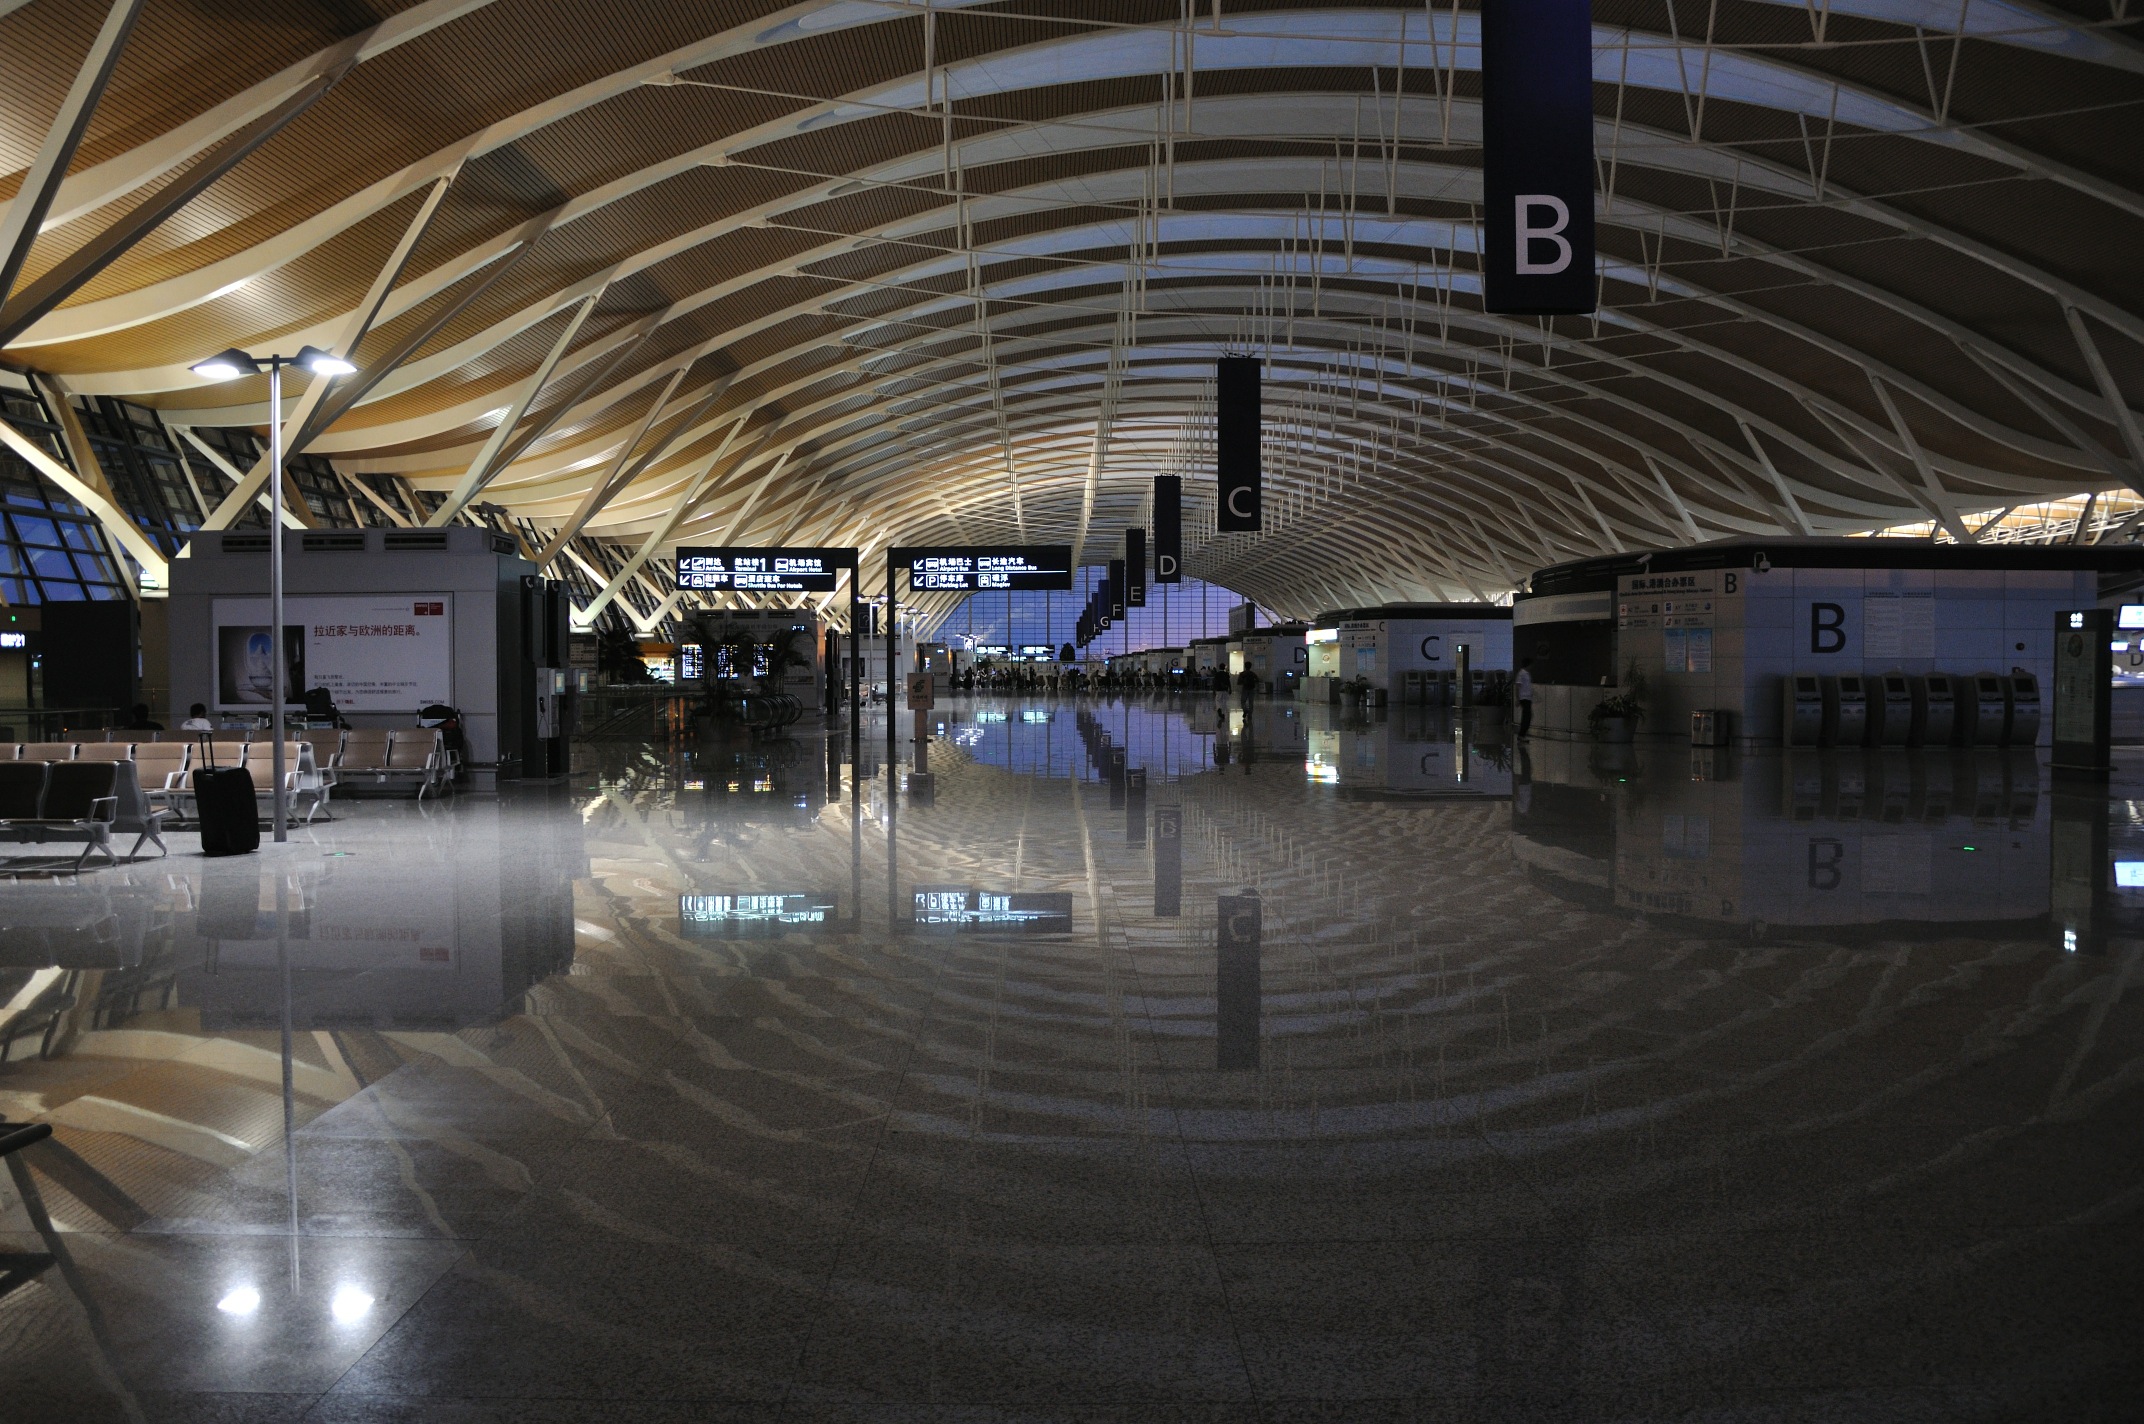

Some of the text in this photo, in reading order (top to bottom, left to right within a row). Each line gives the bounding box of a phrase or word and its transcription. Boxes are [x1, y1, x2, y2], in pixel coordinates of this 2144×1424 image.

[1514, 194, 1573, 276] B
[1228, 486, 1253, 519] C
[939, 558, 972, 566] 机场巴士
[992, 557, 1024, 566] 长途汽车
[1159, 555, 1177, 575] D
[939, 574, 964, 582] 停车库
[1724, 572, 1738, 594] B
[1130, 586, 1142, 602] E
[1112, 604, 1122, 617] F
[1100, 616, 1109, 627] G
[1379, 621, 1385, 632] C
[1811, 602, 1847, 654] B
[313, 624, 421, 638] 拉近家与欧洲的距离。
[1294, 646, 1308, 664] D
[1421, 636, 1440, 661] C
[1171, 658, 1179, 667] G
